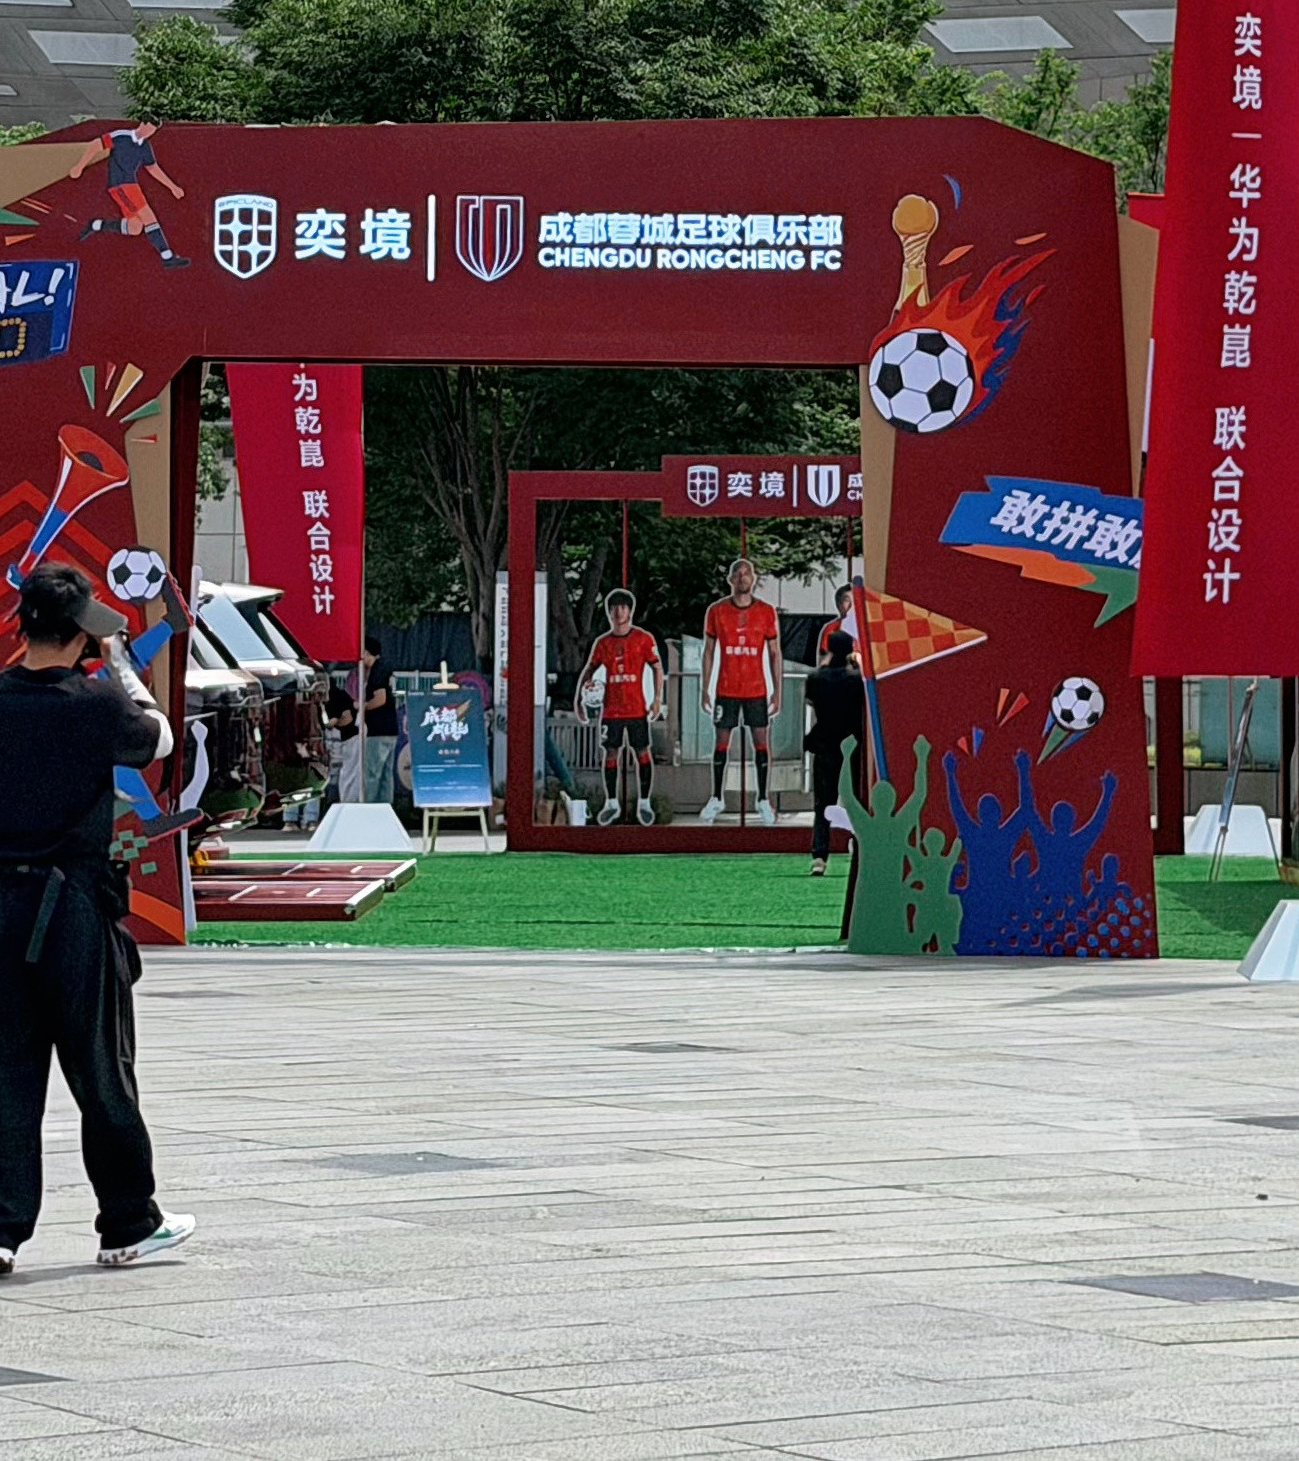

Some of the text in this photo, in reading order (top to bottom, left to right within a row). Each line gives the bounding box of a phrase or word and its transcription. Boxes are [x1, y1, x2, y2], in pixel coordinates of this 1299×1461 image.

[295, 208, 411, 260] 奕境
[538, 211, 842, 247] 成都蓉城足球俱乐部
[538, 247, 842, 271] CHENGDU RONGCHENG FC
[292, 363, 335, 616] 为乾崑 联合设计
[727, 471, 785, 499] 奕境
[1202, 405, 1246, 604] 联合设计
[989, 489, 1142, 569] 敢拼敢
